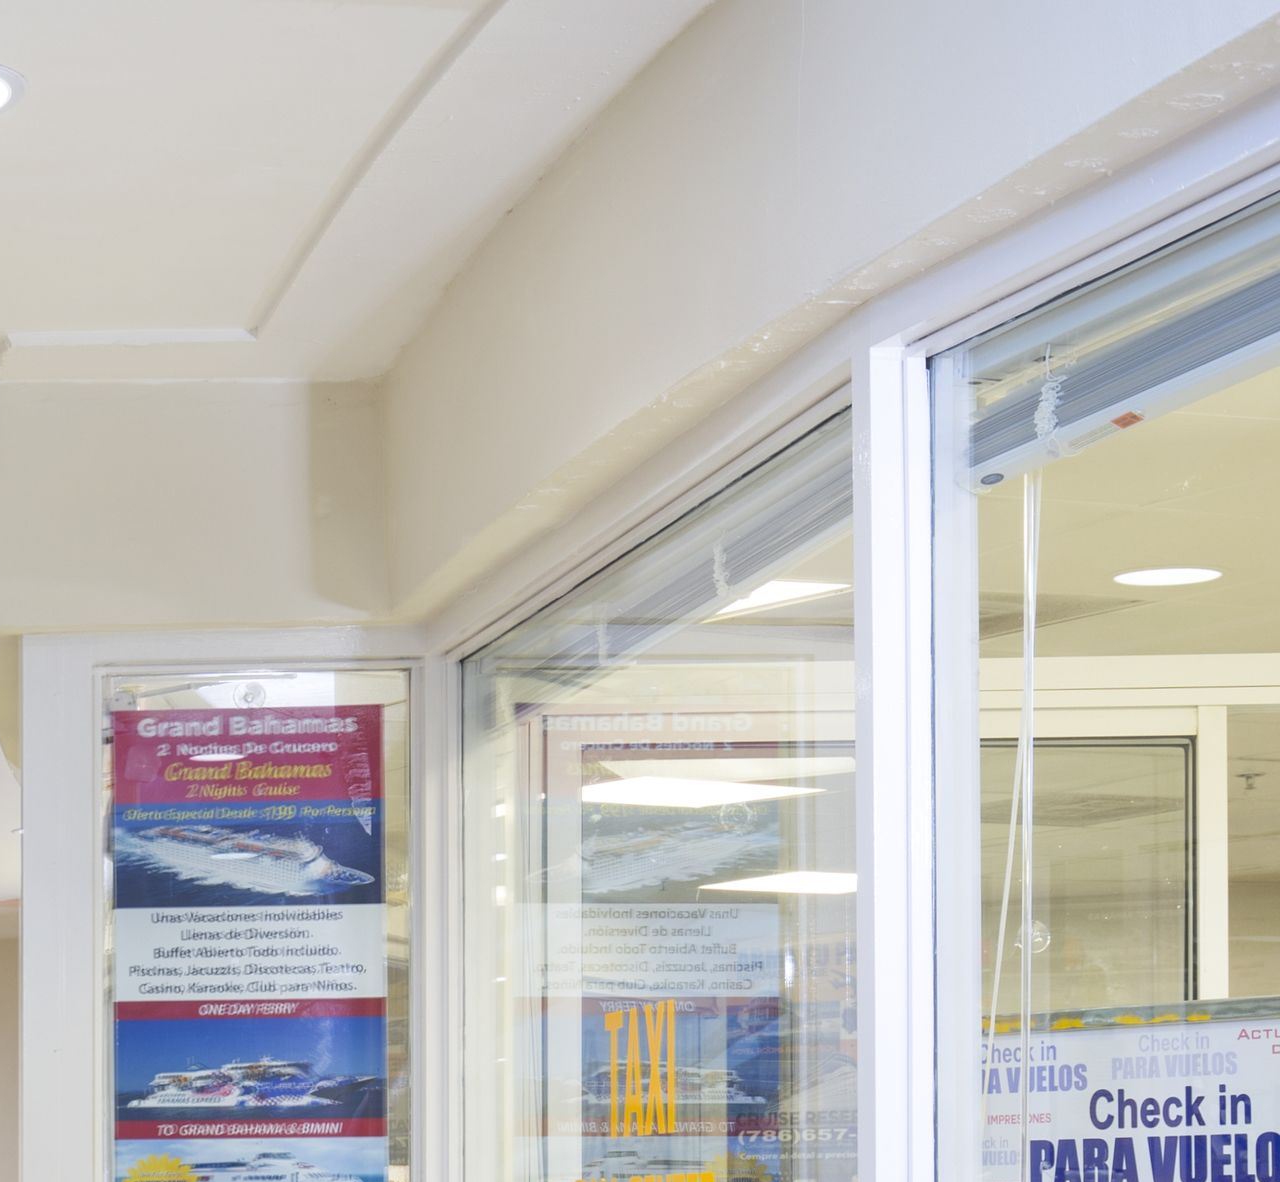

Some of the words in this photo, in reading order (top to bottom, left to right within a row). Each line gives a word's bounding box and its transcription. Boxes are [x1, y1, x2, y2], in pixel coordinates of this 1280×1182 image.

[137, 717, 224, 738] Grand
[229, 714, 359, 736] Bahamas
[164, 763, 232, 782] Grand
[1138, 1032, 1190, 1053] Check
[1195, 1031, 1210, 1049] in
[604, 998, 677, 1139] TAXI
[1112, 1053, 1161, 1080] PARA
[1165, 1051, 1238, 1078] VUELOS
[1089, 1085, 1206, 1130] Check
[1219, 1084, 1252, 1126] in
